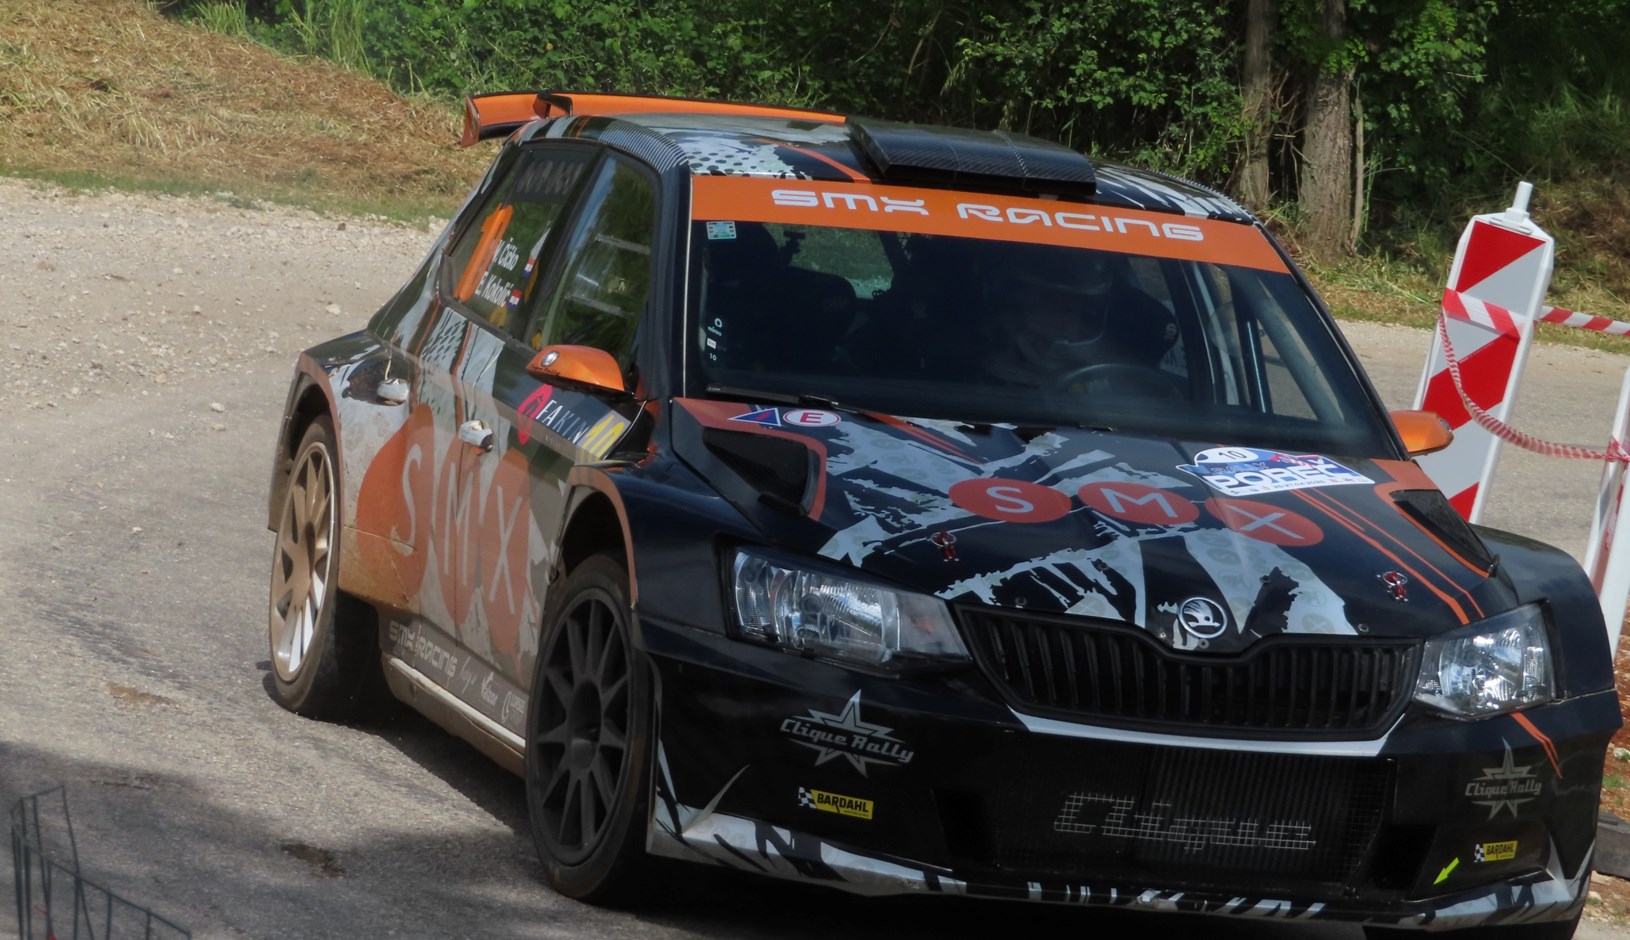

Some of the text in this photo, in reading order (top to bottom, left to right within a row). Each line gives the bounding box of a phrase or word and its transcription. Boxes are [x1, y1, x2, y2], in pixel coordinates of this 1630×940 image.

[771, 189, 1204, 241] SMX RACING
[799, 412, 824, 424] E
[1218, 449, 1247, 460] 10
[780, 718, 914, 763] Clique Rally
[1464, 782, 1508, 798] Clique
[817, 793, 869, 813] BARDAHL
[1053, 792, 1317, 854] Clique
[1486, 843, 1514, 860] BARDAHL
